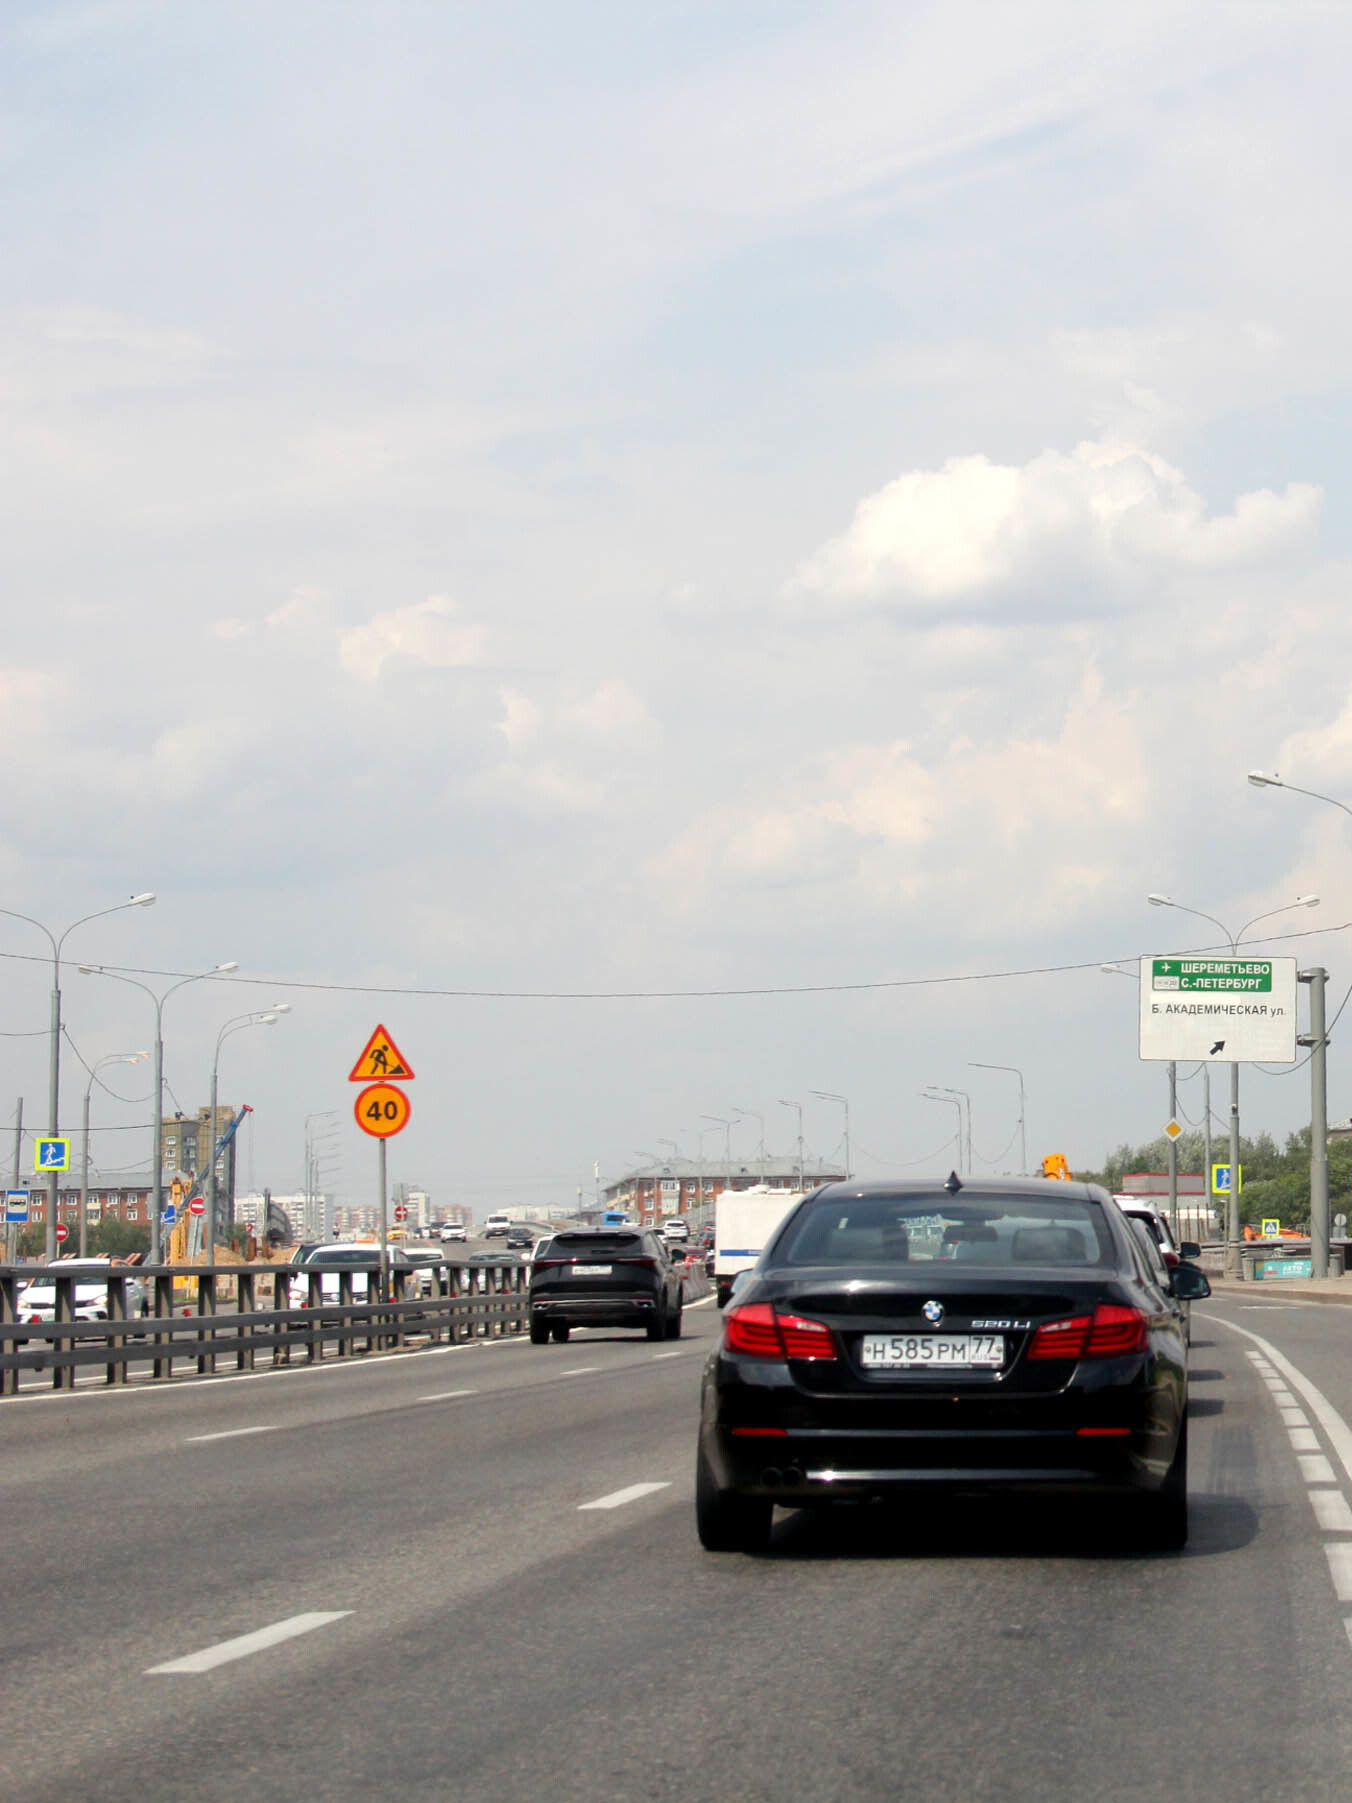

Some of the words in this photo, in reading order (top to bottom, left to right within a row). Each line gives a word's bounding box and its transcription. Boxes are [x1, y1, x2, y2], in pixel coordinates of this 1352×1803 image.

[1181, 963, 1270, 975] ШЕРЕМЕТЬЕВО
[1181, 978, 1262, 989] С.-ПЕТЕРБУРГ
[1152, 1004, 1163, 1014] Б.
[1166, 1004, 1267, 1016] АКАДЕМИЧЕСКАЯ
[1270, 1008, 1287, 1018] ул.
[366, 1101, 399, 1121] 40
[973, 1336, 995, 1353] 77
